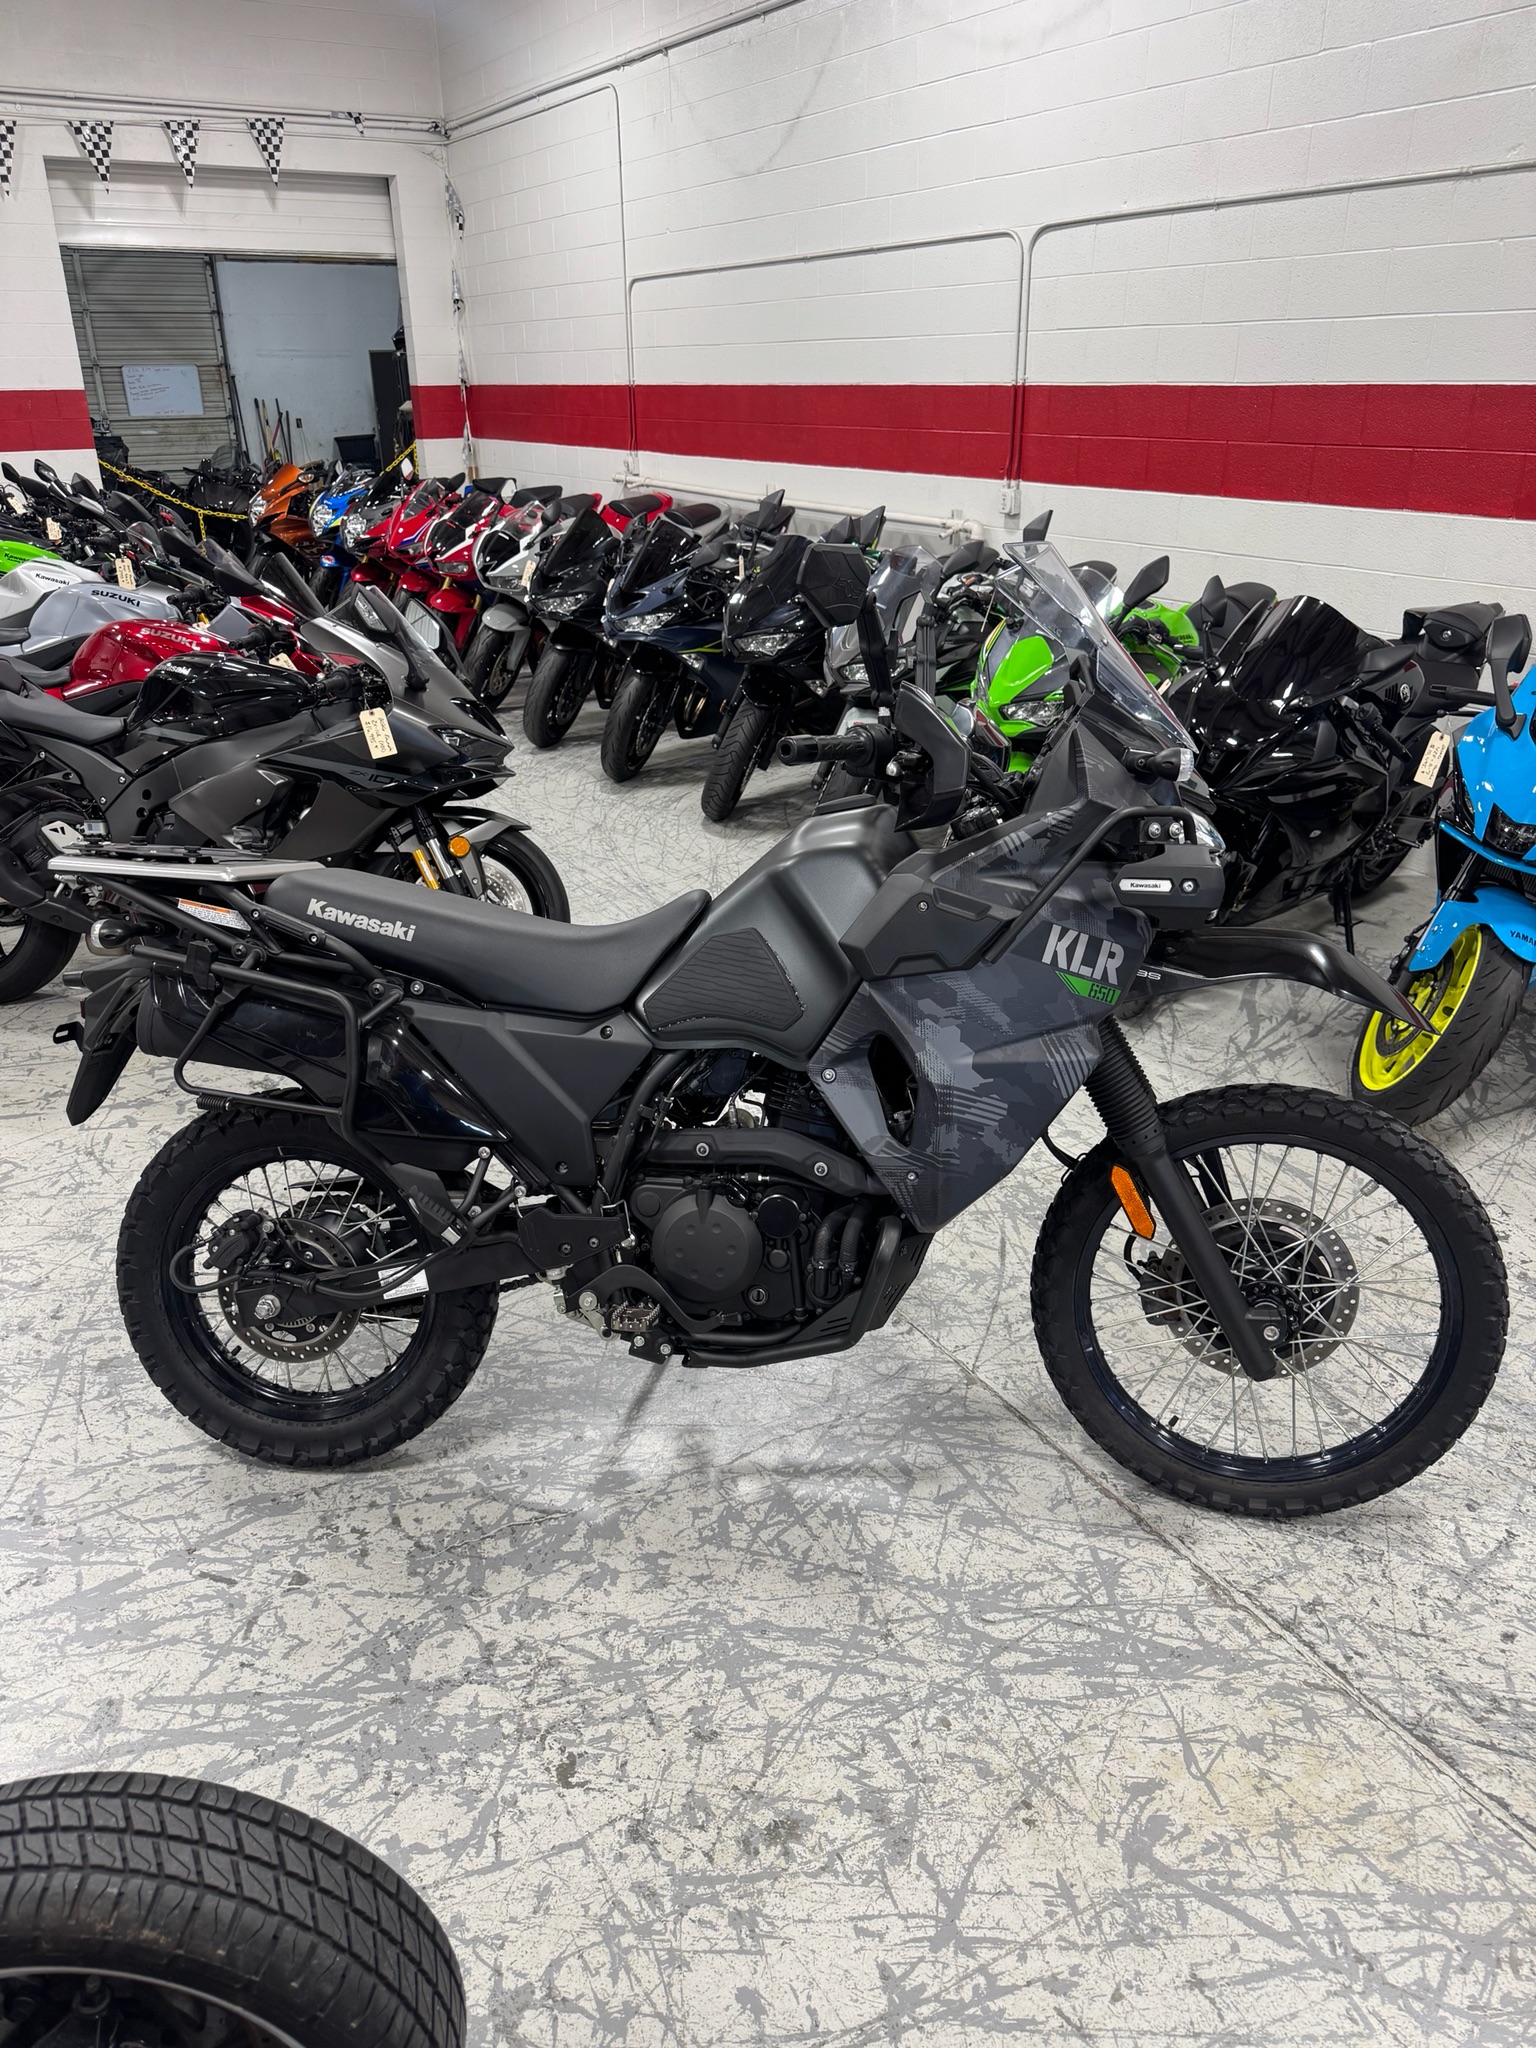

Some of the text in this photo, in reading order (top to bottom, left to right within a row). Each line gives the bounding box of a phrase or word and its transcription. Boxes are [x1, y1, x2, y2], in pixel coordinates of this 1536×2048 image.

[4, 552, 31, 562] Kawasa
[35, 572, 70, 586] Kawasaki
[91, 589, 141, 608] SUZUKI
[140, 627, 201, 651] SUZUKI
[306, 897, 417, 942] Kawasaki
[1510, 929, 1536, 947] YAMA
[1041, 923, 1125, 986] KLR
[1087, 982, 1116, 1004] 650
